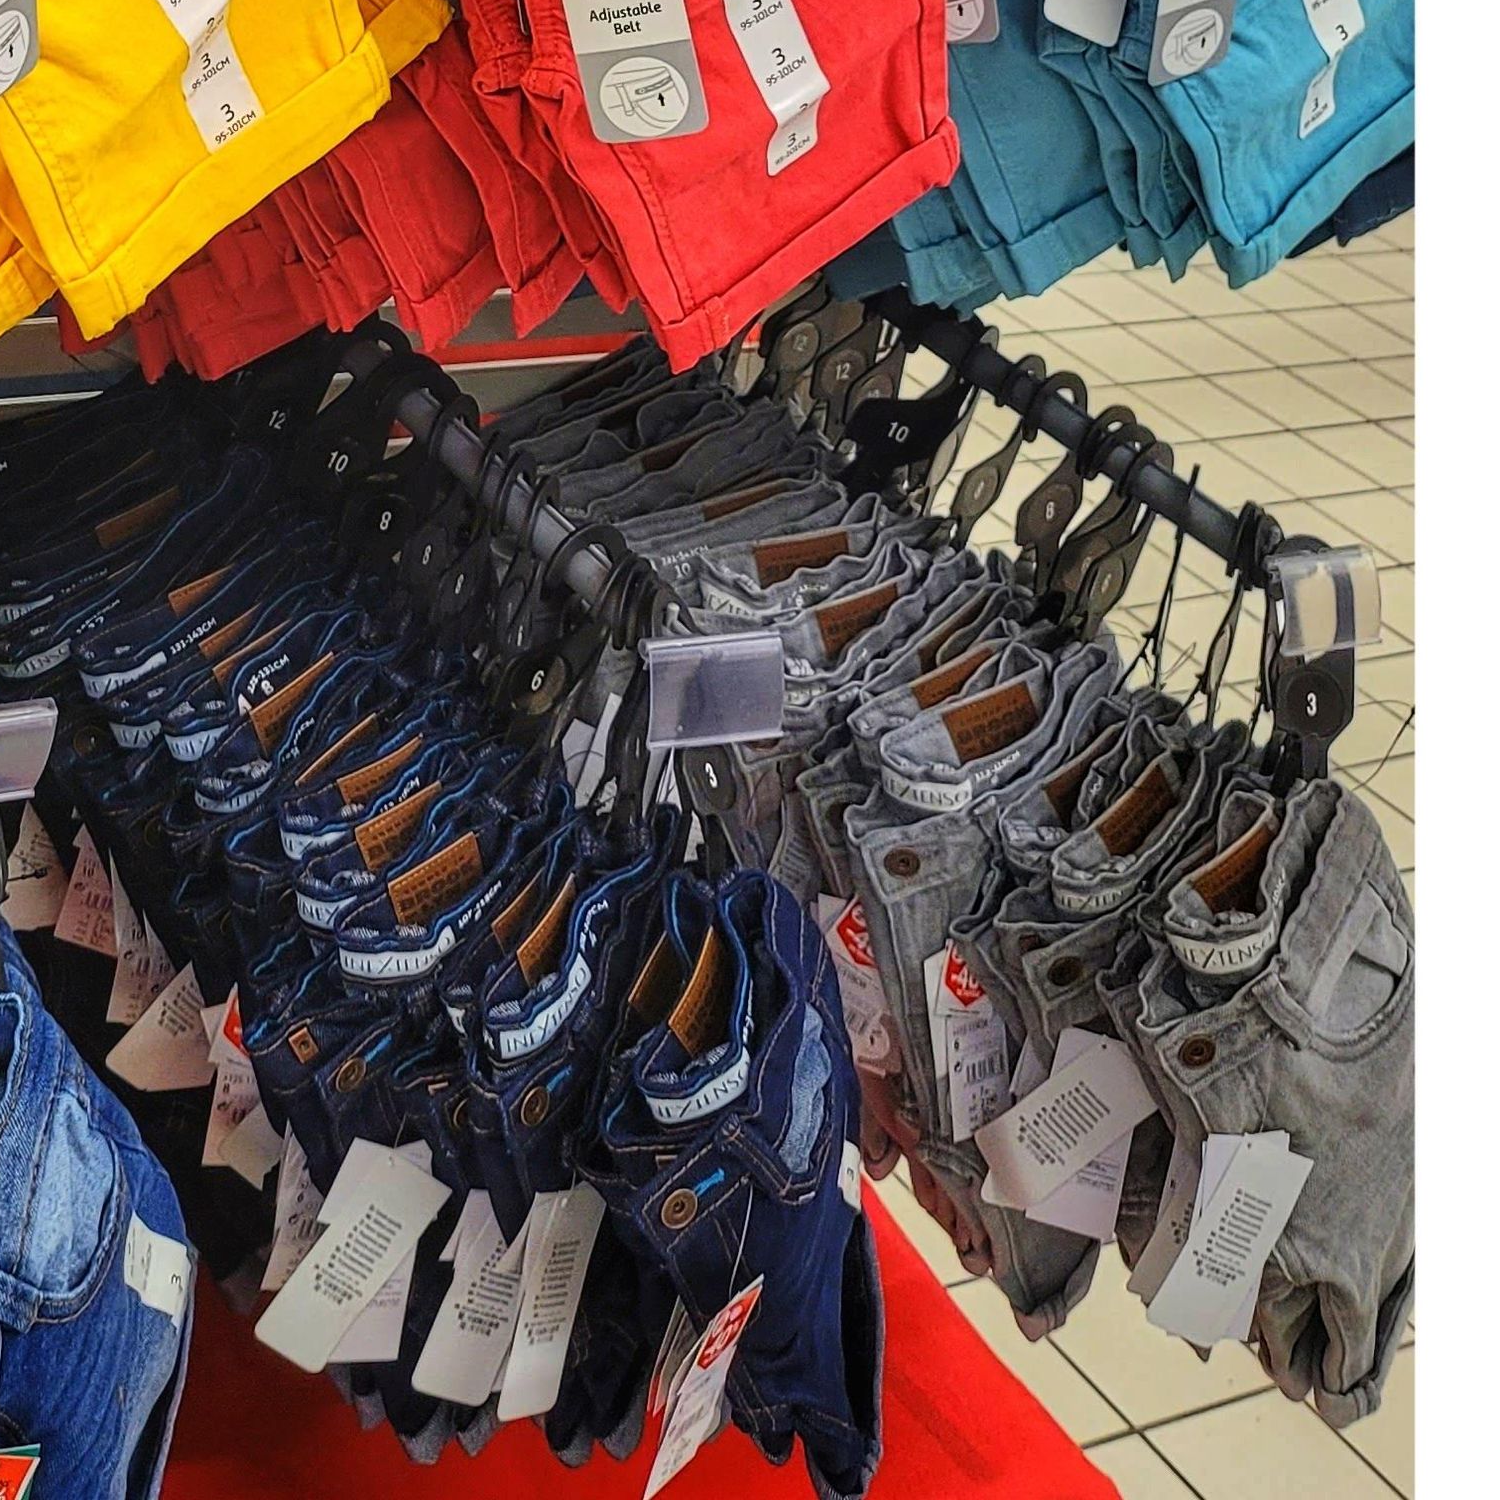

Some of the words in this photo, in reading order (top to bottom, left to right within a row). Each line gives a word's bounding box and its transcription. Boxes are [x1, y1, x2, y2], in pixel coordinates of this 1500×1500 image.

[589, 1, 662, 25] Adjustable
[739, 0, 784, 32] 95-101CM
[613, 20, 642, 36] Belt
[1335, 23, 1350, 41] 3
[200, 52, 212, 70] 3
[771, 47, 786, 66] 3
[191, 56, 231, 92] 95-101CM
[765, 56, 807, 88] 95-101CM
[220, 103, 236, 123] 3
[1311, 96, 1320, 113] 3
[214, 110, 257, 145] 95-101CM
[787, 133, 797, 148] 3
[835, 363, 851, 381] 12
[268, 409, 288, 431] 12
[887, 420, 910, 443] 10
[327, 449, 349, 473] 10
[379, 510, 392, 532] 8
[530, 669, 546, 693] 6
[1306, 692, 1318, 717] 3
[704, 761, 718, 789] 3
